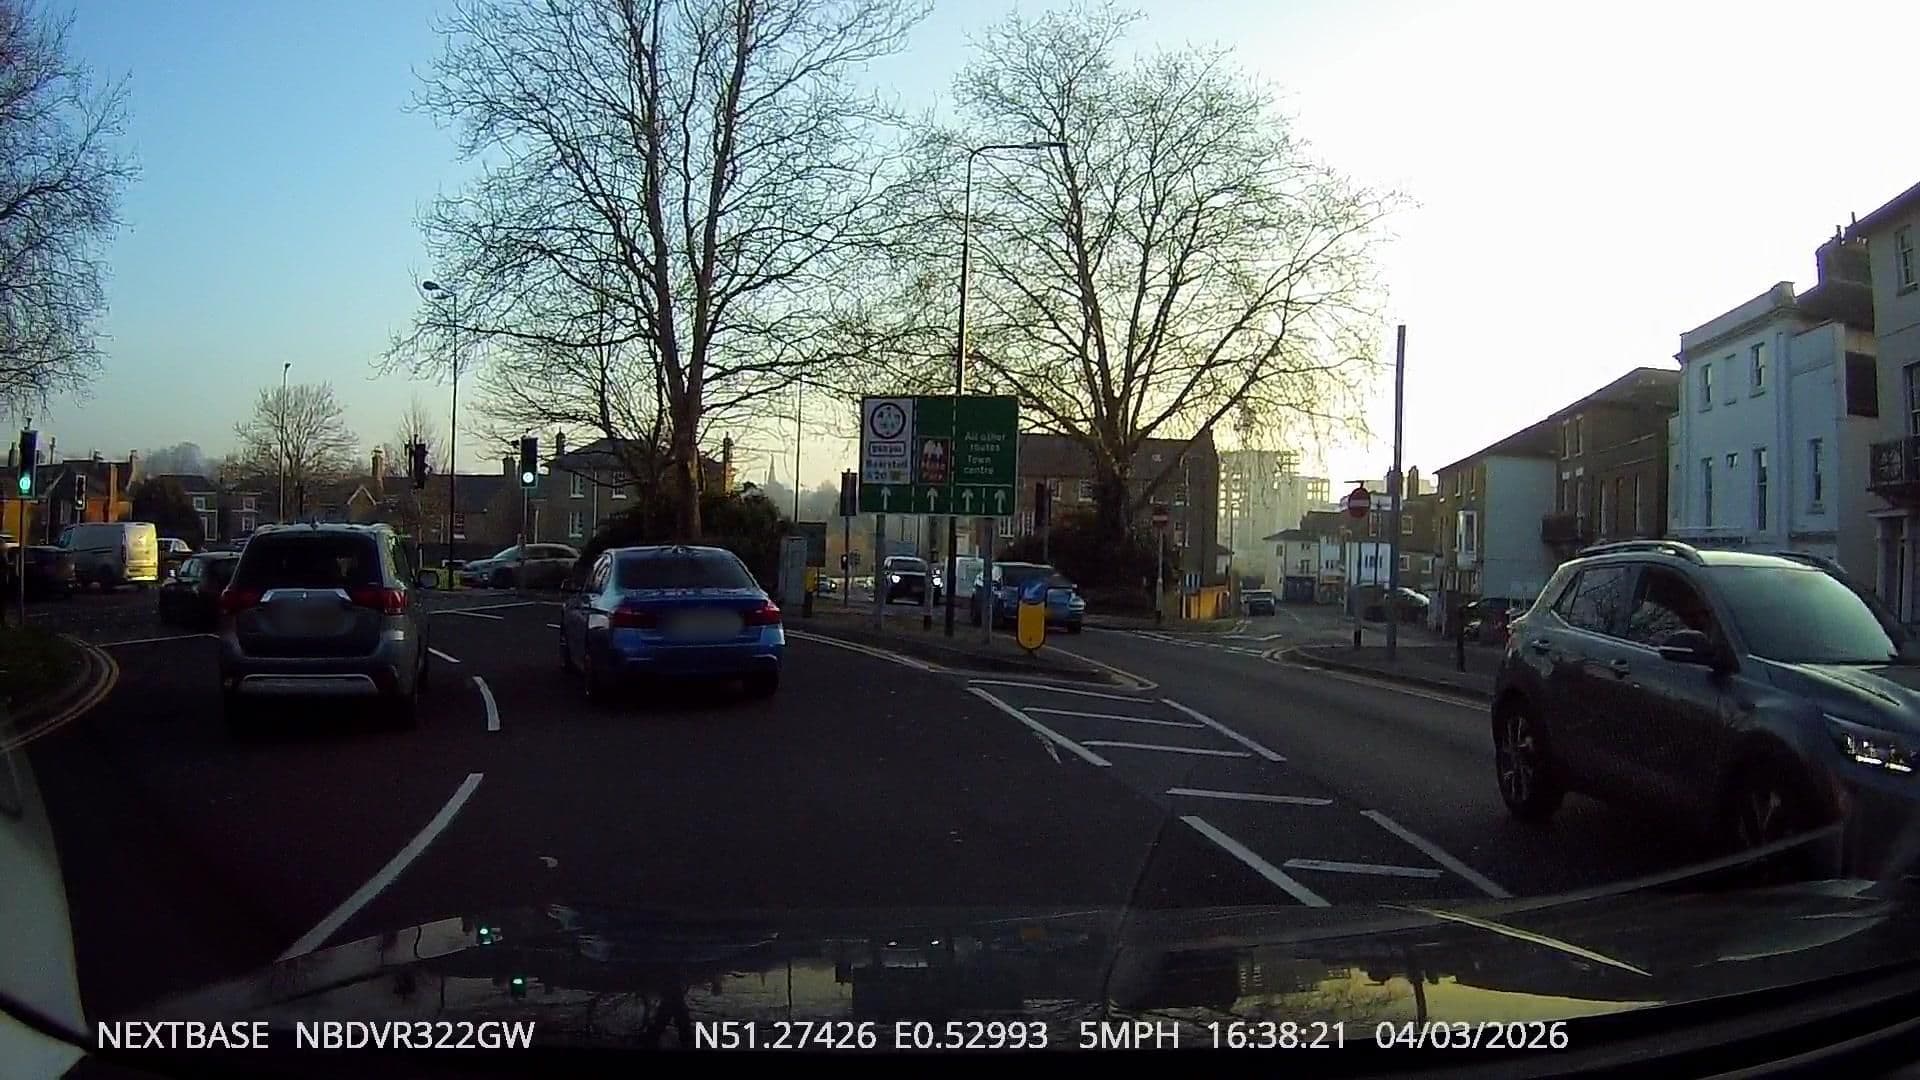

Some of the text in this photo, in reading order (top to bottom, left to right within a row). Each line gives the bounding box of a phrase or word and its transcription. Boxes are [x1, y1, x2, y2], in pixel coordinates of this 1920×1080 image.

[965, 432, 1006, 441] All other
[970, 443, 1001, 452] routes
[967, 455, 992, 464] Town
[963, 466, 995, 475] centre
